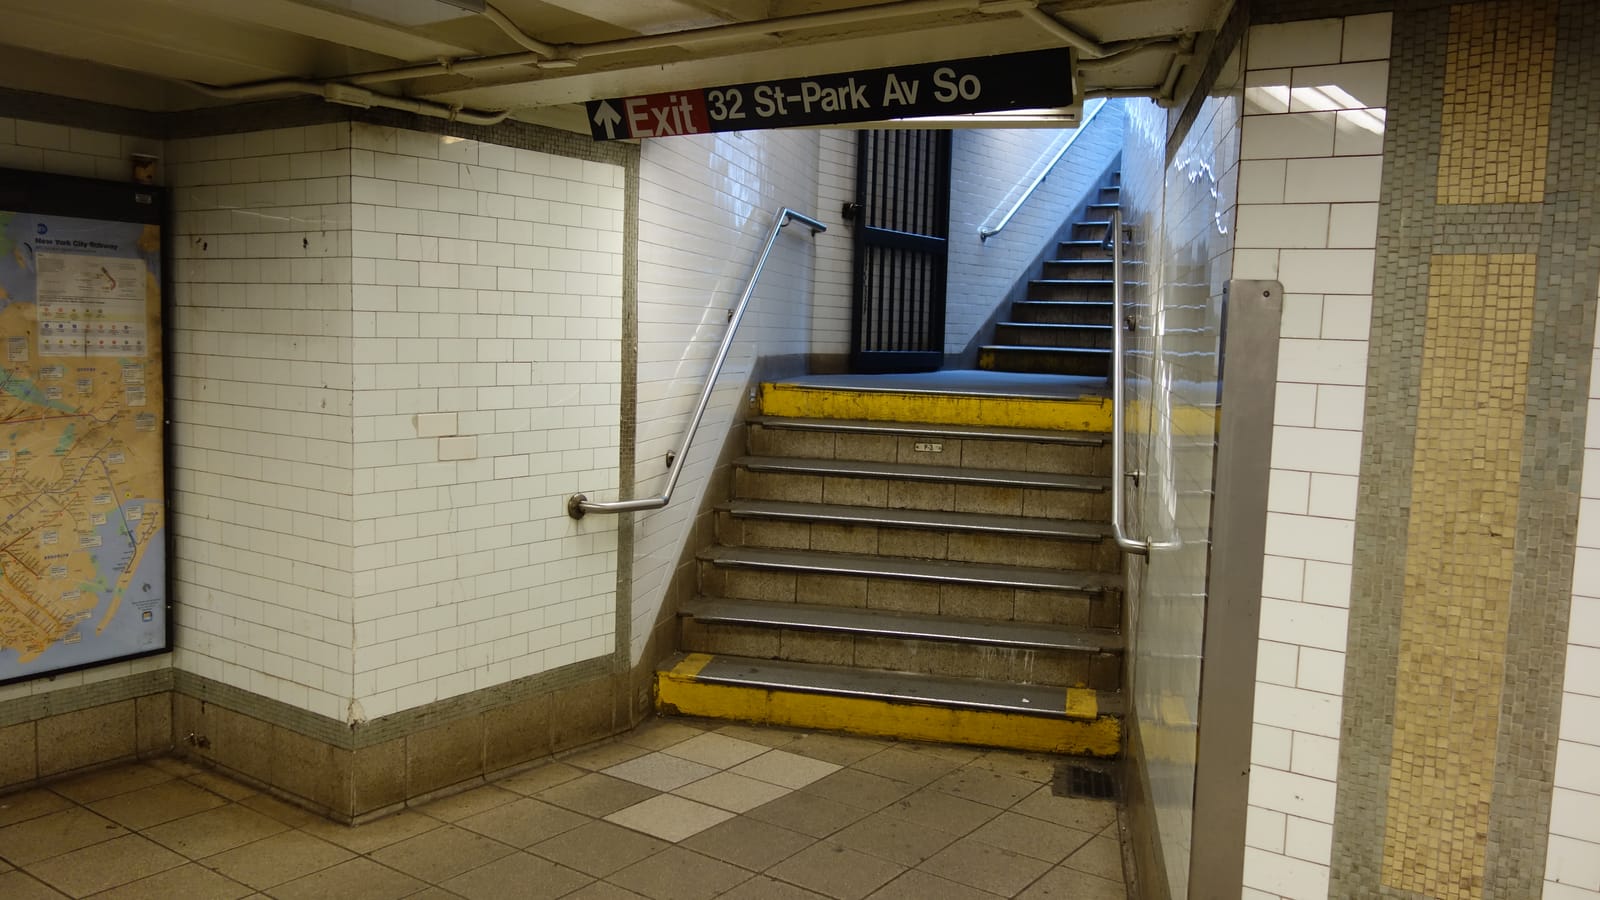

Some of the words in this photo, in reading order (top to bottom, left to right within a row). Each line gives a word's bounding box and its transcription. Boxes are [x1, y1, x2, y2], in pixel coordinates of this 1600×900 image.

[624, 95, 698, 138] Exit
[708, 88, 746, 121] 32
[753, 77, 871, 118] St-Park
[882, 73, 919, 107] Av
[933, 67, 982, 103] So
[73, 240, 88, 248] City
